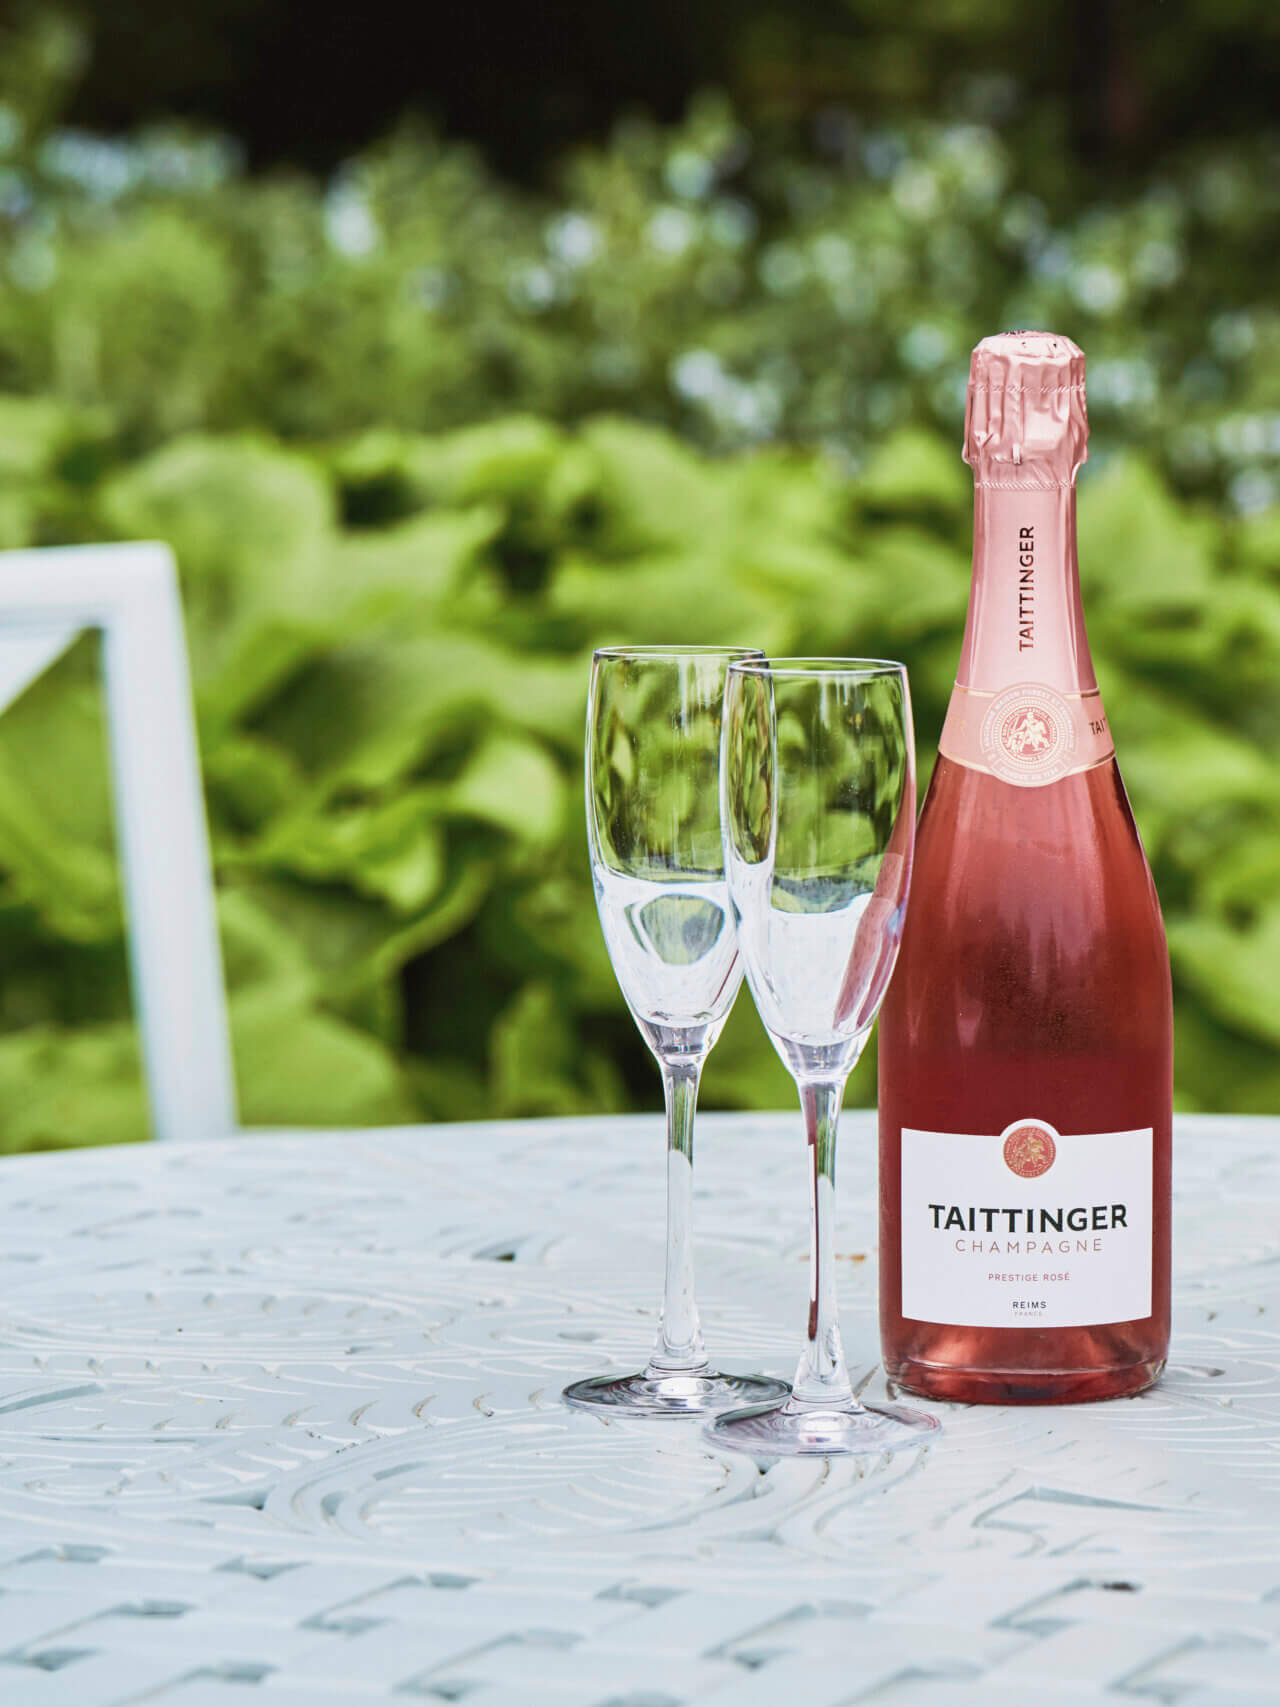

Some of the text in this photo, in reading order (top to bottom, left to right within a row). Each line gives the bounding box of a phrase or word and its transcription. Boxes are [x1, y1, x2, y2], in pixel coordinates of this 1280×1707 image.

[1019, 526, 1034, 652] TAITTINGER
[1088, 718, 1106, 736] TAI
[928, 1204, 1128, 1233] TAITTINGER
[955, 1238, 1104, 1254] CHAMPAGNE
[988, 1272, 1070, 1282] PRESTIGE ROSÉ
[1012, 1301, 1047, 1309] REIMS
